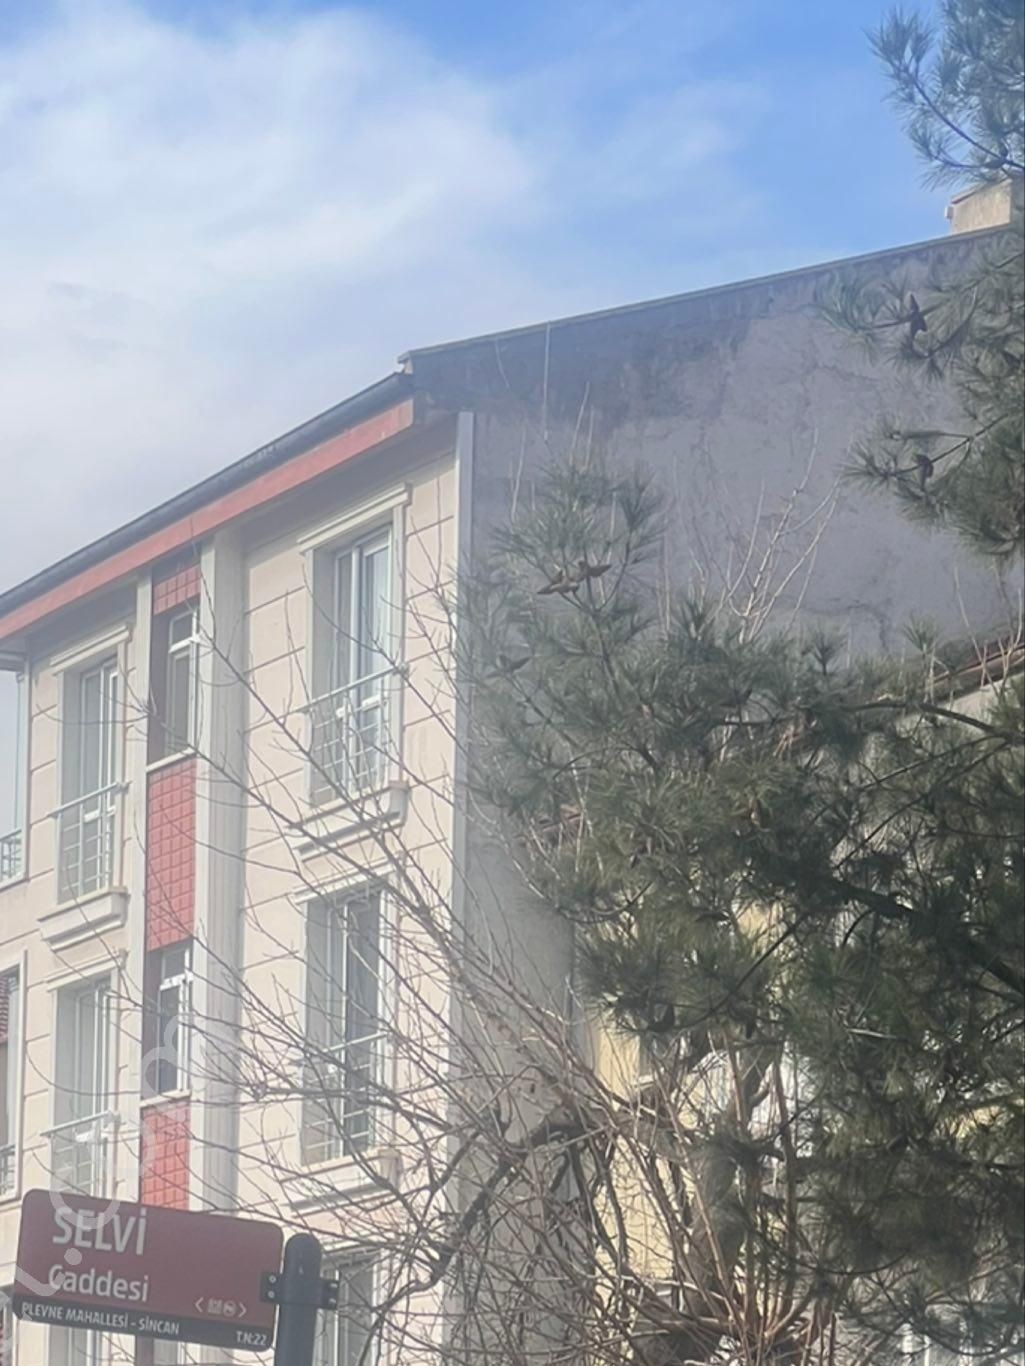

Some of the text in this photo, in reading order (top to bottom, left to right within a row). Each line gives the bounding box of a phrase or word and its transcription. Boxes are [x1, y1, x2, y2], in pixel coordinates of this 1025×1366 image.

[52, 1206, 147, 1254] SELVİ
[49, 1264, 149, 1301] Caddesi
[22, 1302, 63, 1320] PLEVNE
[65, 1307, 128, 1327] MAHALLESİ
[139, 1315, 180, 1335] SİNCAN
